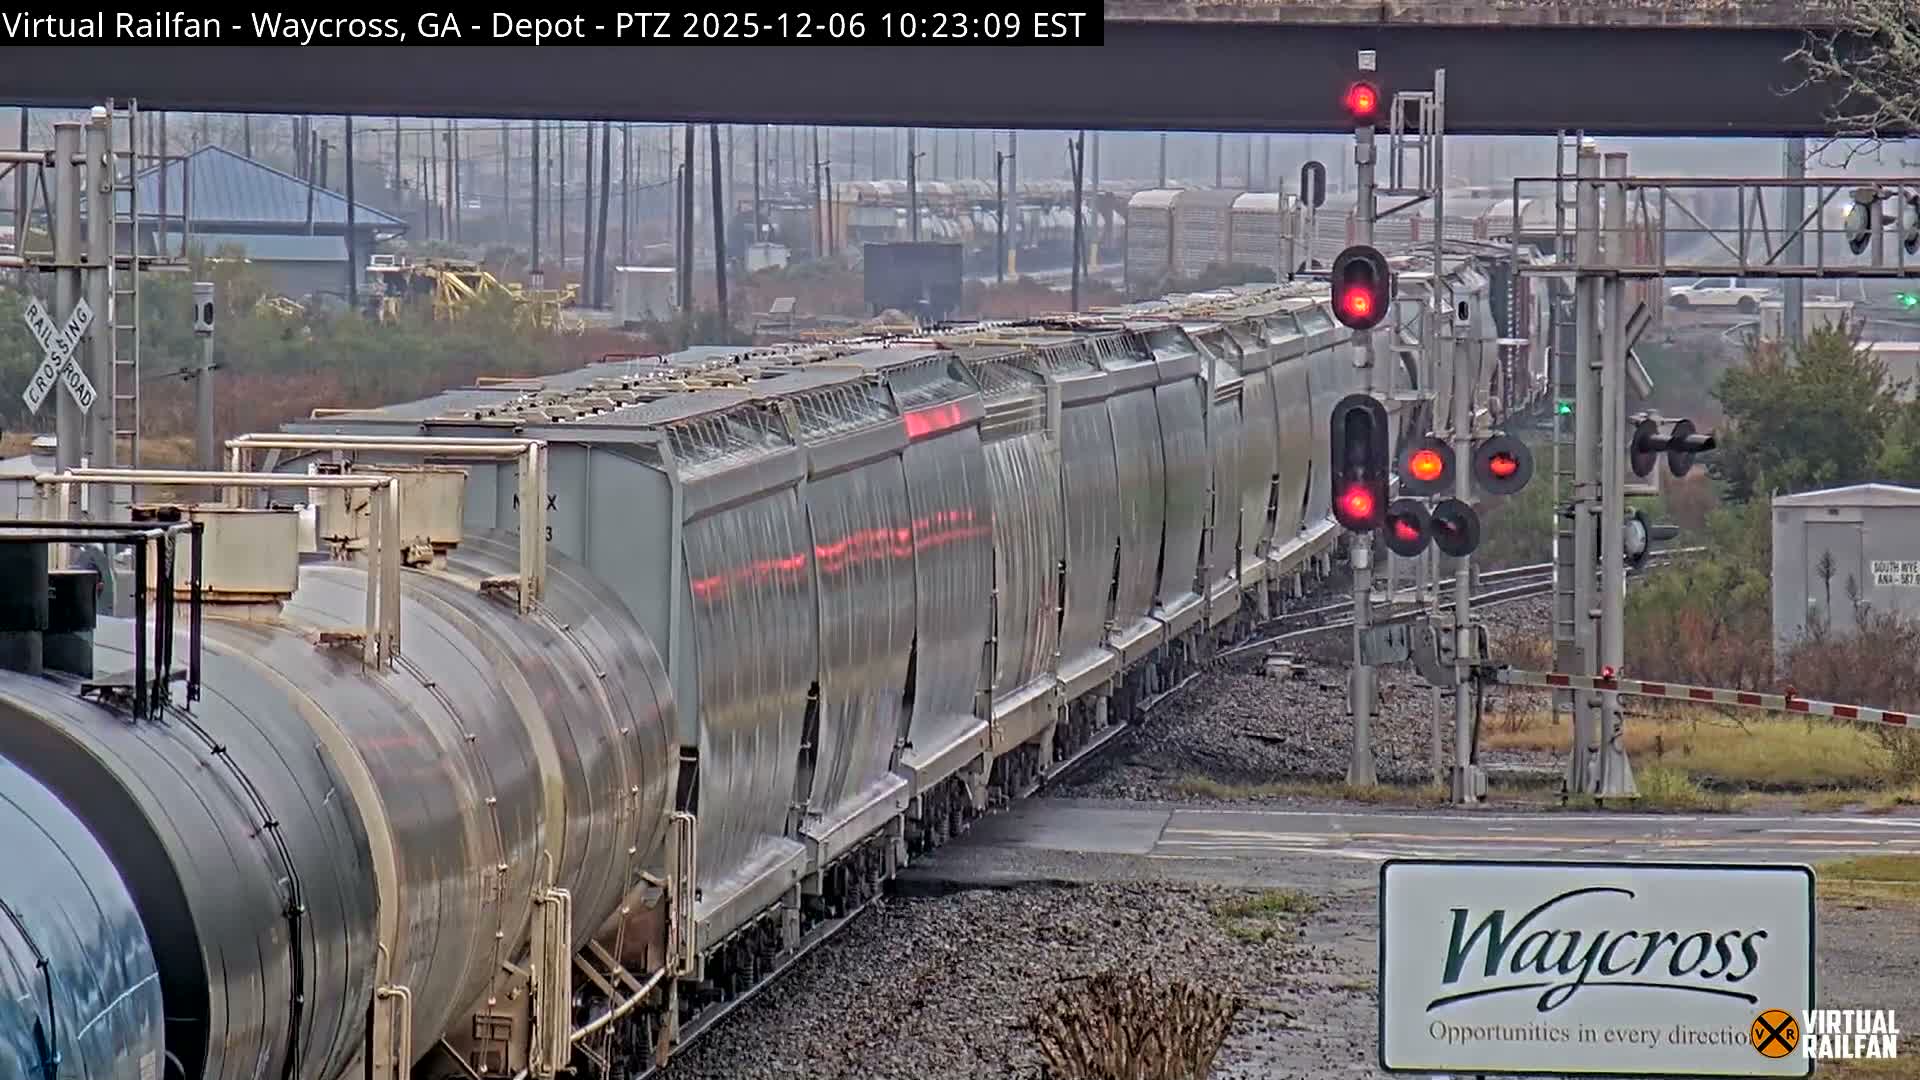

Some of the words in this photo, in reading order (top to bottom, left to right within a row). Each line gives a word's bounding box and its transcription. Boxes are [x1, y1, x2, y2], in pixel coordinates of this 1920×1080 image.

[29, 308, 88, 404] CROSSING
[1873, 562, 1899, 573] SOUTH
[1442, 887, 1768, 1012] Waycross
[1429, 1020, 1569, 1045] Opportunities
[1578, 1024, 1597, 1042] in
[1604, 1027, 1660, 1048] every
[1667, 1024, 1751, 1046] directio
